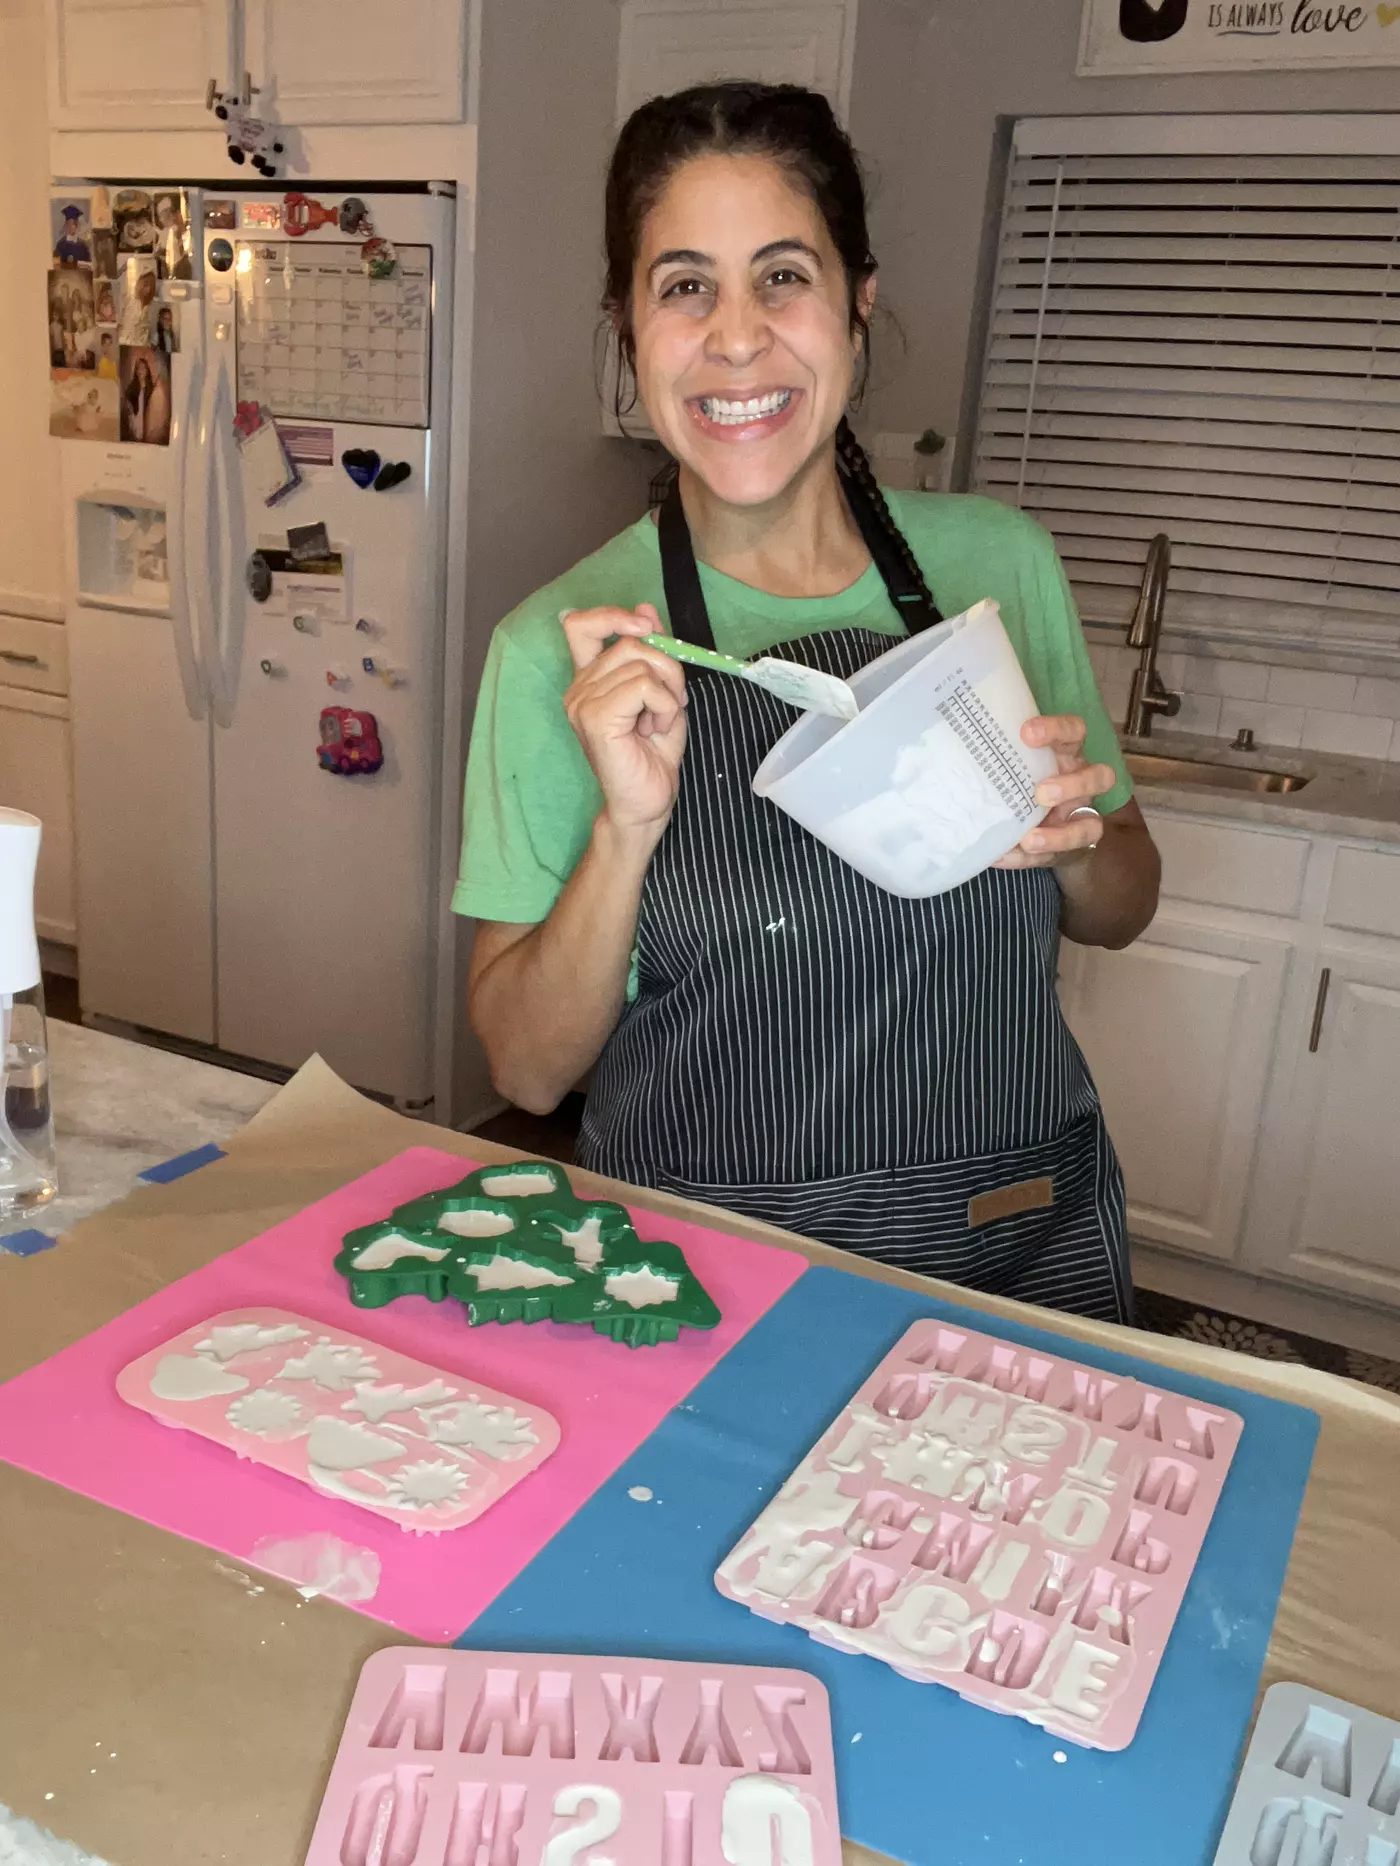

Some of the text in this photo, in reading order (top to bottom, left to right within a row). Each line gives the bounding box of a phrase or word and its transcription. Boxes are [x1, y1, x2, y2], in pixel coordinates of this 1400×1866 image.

[1207, 0, 1368, 34] IS ALWAYS love
